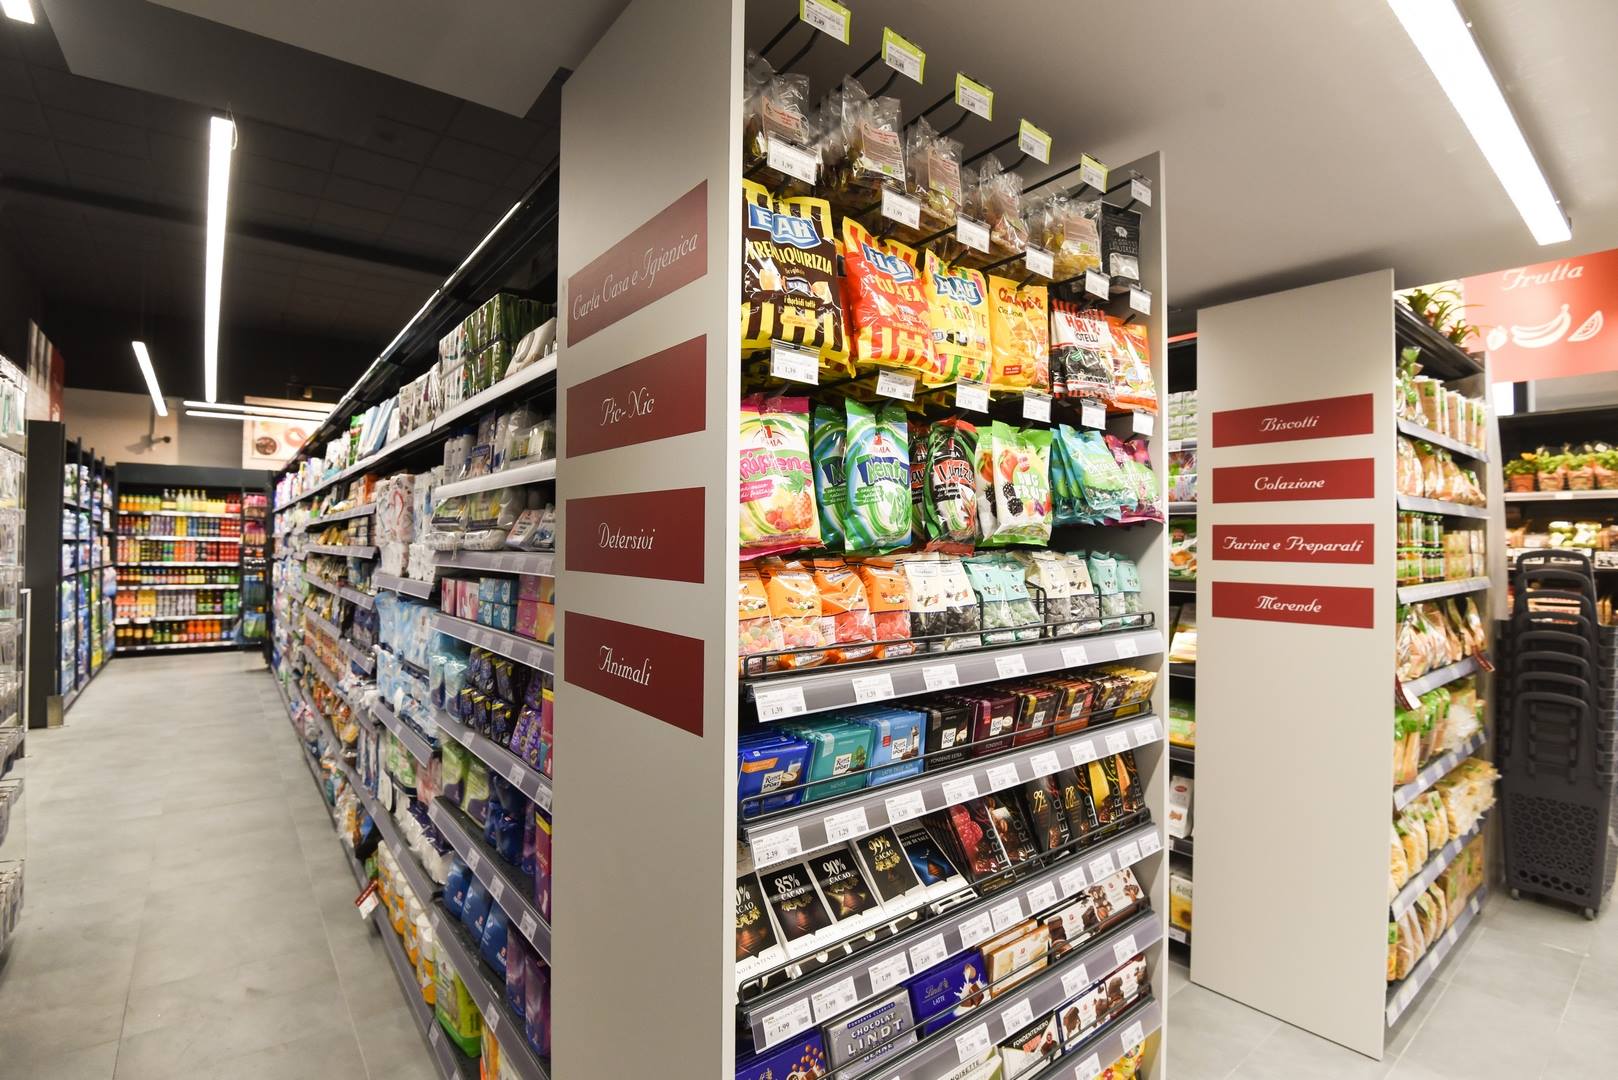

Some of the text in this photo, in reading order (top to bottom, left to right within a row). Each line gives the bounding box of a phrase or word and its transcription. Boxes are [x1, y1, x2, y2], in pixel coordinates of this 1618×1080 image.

[573, 233, 698, 320] Carta Casa e Igienica
[1502, 262, 1584, 291] Frutta
[1260, 416, 1320, 432] Biscotti
[1254, 476, 1325, 491] Colazione
[599, 522, 656, 550] Detersivi
[1222, 535, 1364, 555] Farine e Preparati
[1256, 595, 1322, 613] Merende
[599, 645, 652, 686] Animali
[771, 706, 784, 715] 1,39
[1053, 798, 1071, 847] NERO
[868, 833, 891, 855] 99%
[874, 849, 894, 863] CACAO
[822, 857, 847, 877] 90%
[774, 872, 801, 895] 85%
[829, 871, 851, 885] CACAO
[736, 886, 751, 908] 0%
[781, 887, 805, 901] CACAO
[736, 901, 754, 915] ACAO
[825, 999, 836, 1009] 1,99
[932, 995, 945, 1006] LATTE
[777, 1022, 790, 1033] 1,99
[848, 1014, 872, 1028] FONDENTE
[851, 1012, 896, 1039] CHOCOLAT
[847, 1018, 904, 1056] LINDT
